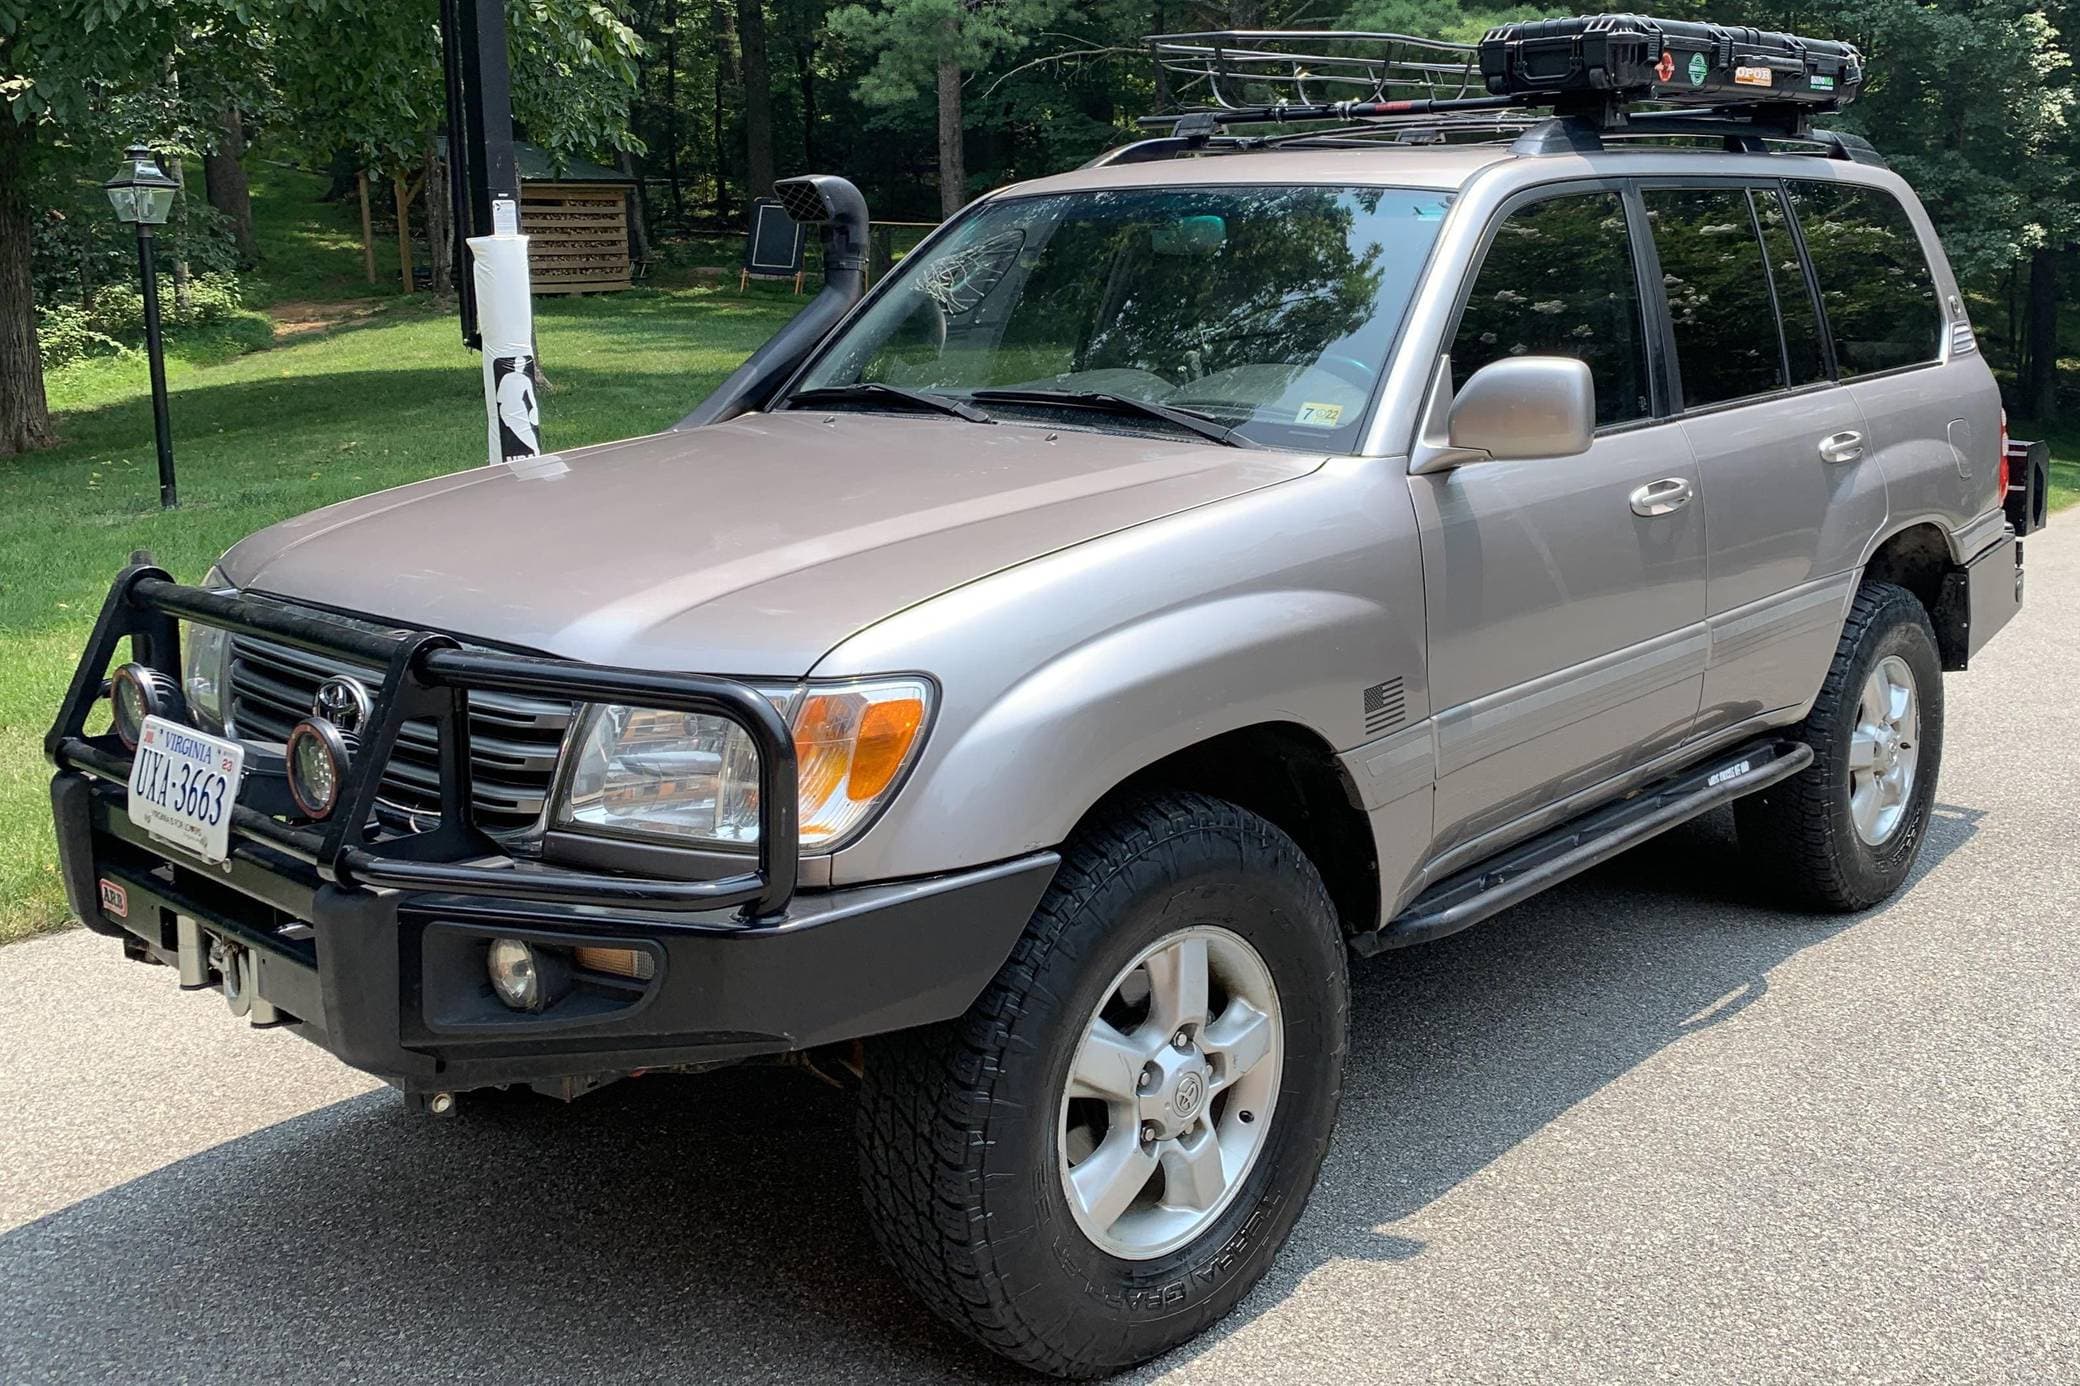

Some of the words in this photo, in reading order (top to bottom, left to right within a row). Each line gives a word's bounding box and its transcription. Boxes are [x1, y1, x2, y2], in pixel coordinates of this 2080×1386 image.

[1304, 408, 1315, 420] 7
[1326, 409, 1339, 420] 22
[166, 732, 212, 764] VIRGINIA
[222, 758, 233, 772] 23
[103, 886, 124, 909] ARB
